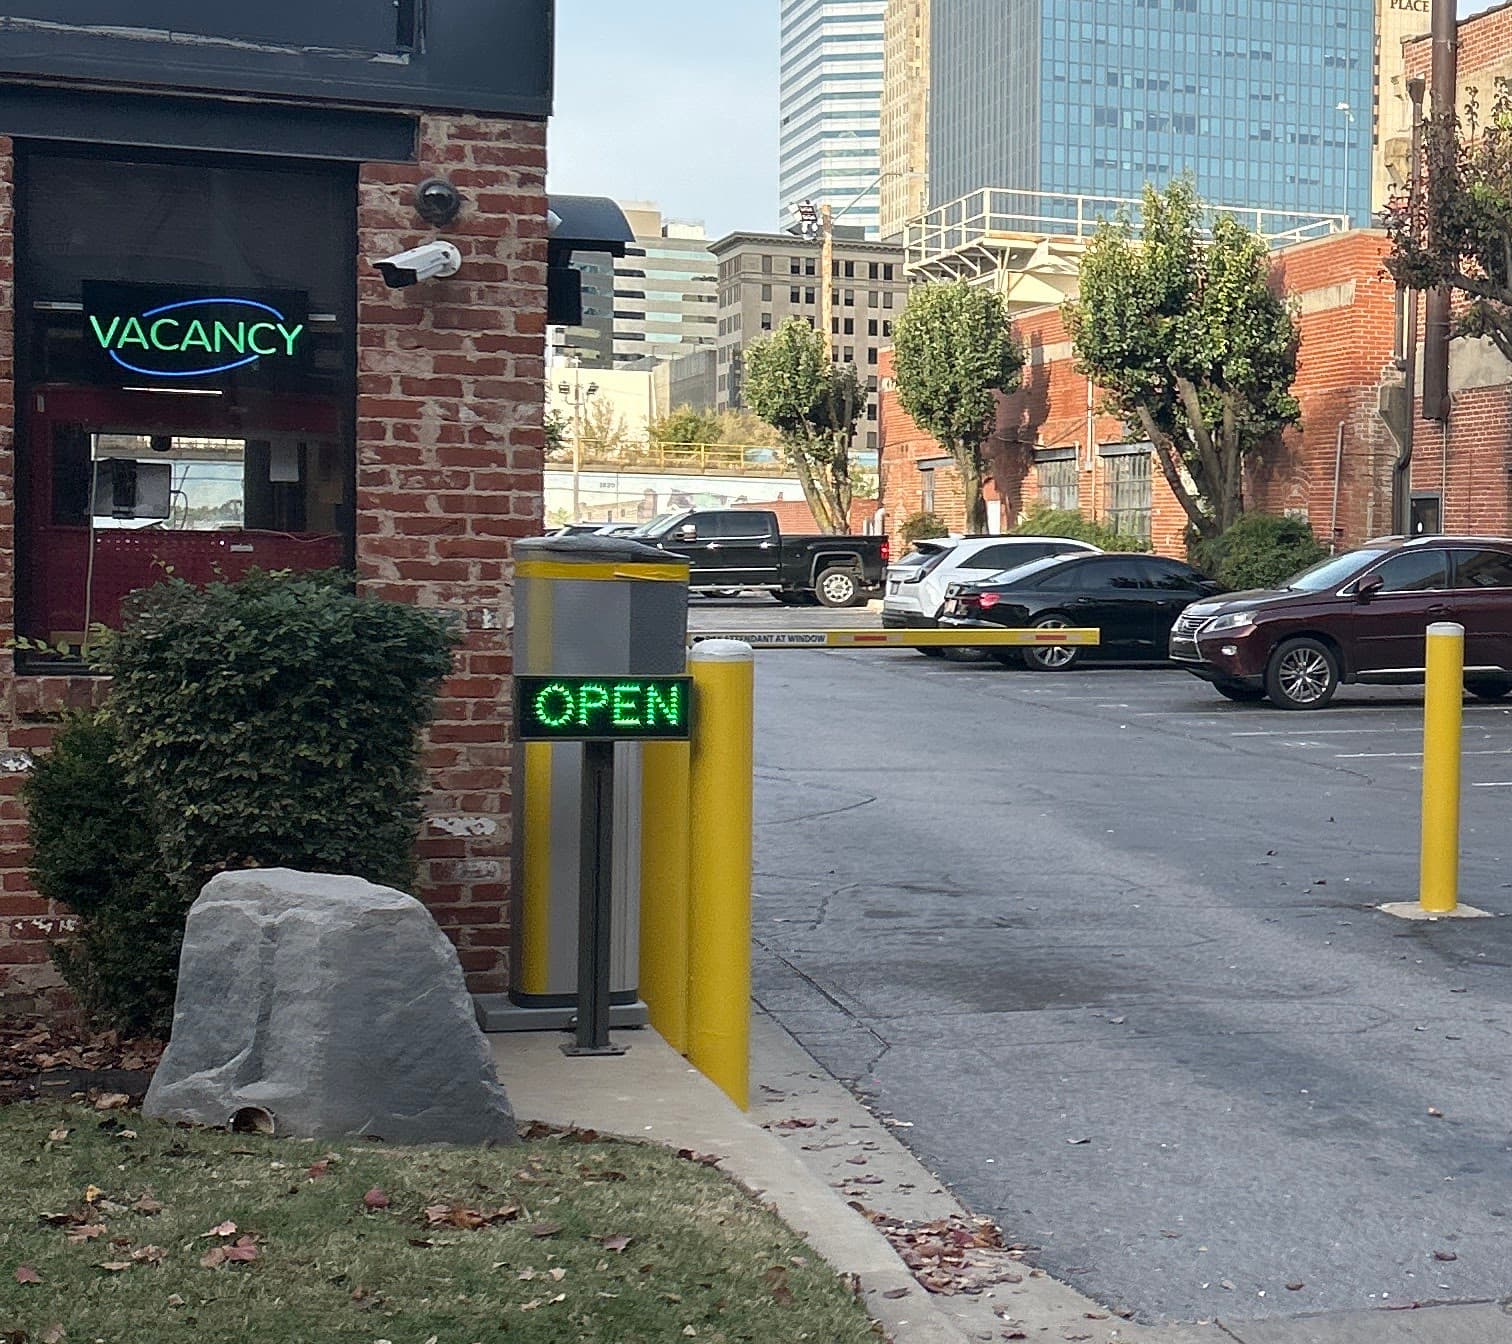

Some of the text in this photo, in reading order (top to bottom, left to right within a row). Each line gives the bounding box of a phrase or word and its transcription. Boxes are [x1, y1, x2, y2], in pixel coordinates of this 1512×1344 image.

[89, 314, 304, 356] VACANCY
[775, 635, 786, 643] AT
[788, 635, 825, 643] WINDOW
[535, 683, 680, 727] OPEN
